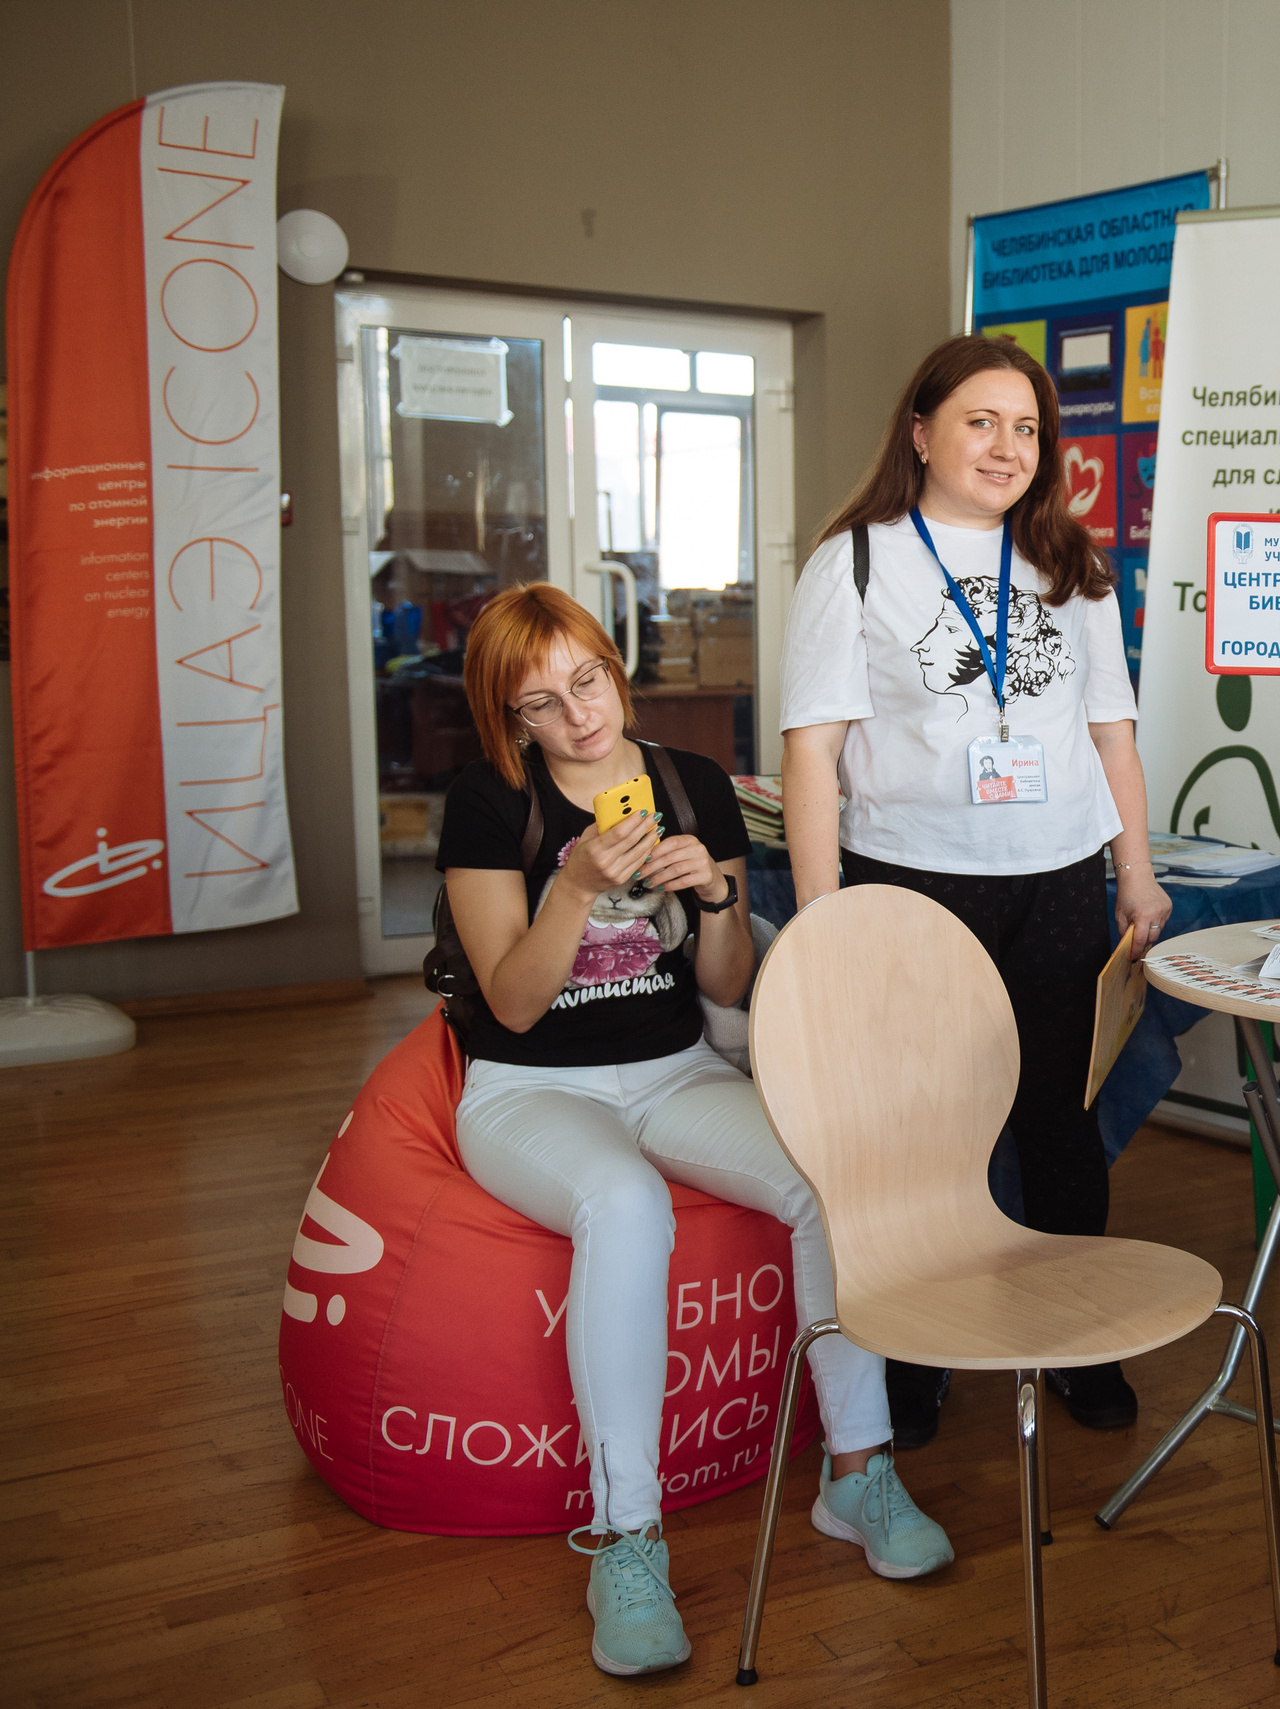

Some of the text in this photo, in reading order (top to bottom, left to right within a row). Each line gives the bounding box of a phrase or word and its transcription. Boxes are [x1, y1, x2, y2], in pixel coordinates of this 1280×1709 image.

[991, 203, 1196, 258] ЧЕЛЯБИНСКАЯ ОБЛАСТНА
[982, 259, 1076, 290] БИБЛИОТЕКА
[1079, 252, 1111, 279] ДЛЯ
[97, 480, 147, 491] центры
[1213, 467, 1256, 488] для
[69, 496, 148, 512] по атомной
[93, 516, 148, 528] энергии
[81, 552, 149, 566] information
[105, 570, 150, 582] centers
[84, 586, 150, 602] on nuclear
[107, 606, 149, 619] energy
[1011, 758, 1039, 768] Ирина
[535, 1264, 784, 1338] УБНО
[280, 1365, 334, 1461] ONE
[381, 1392, 769, 1468] СЛОЖИСЬ
